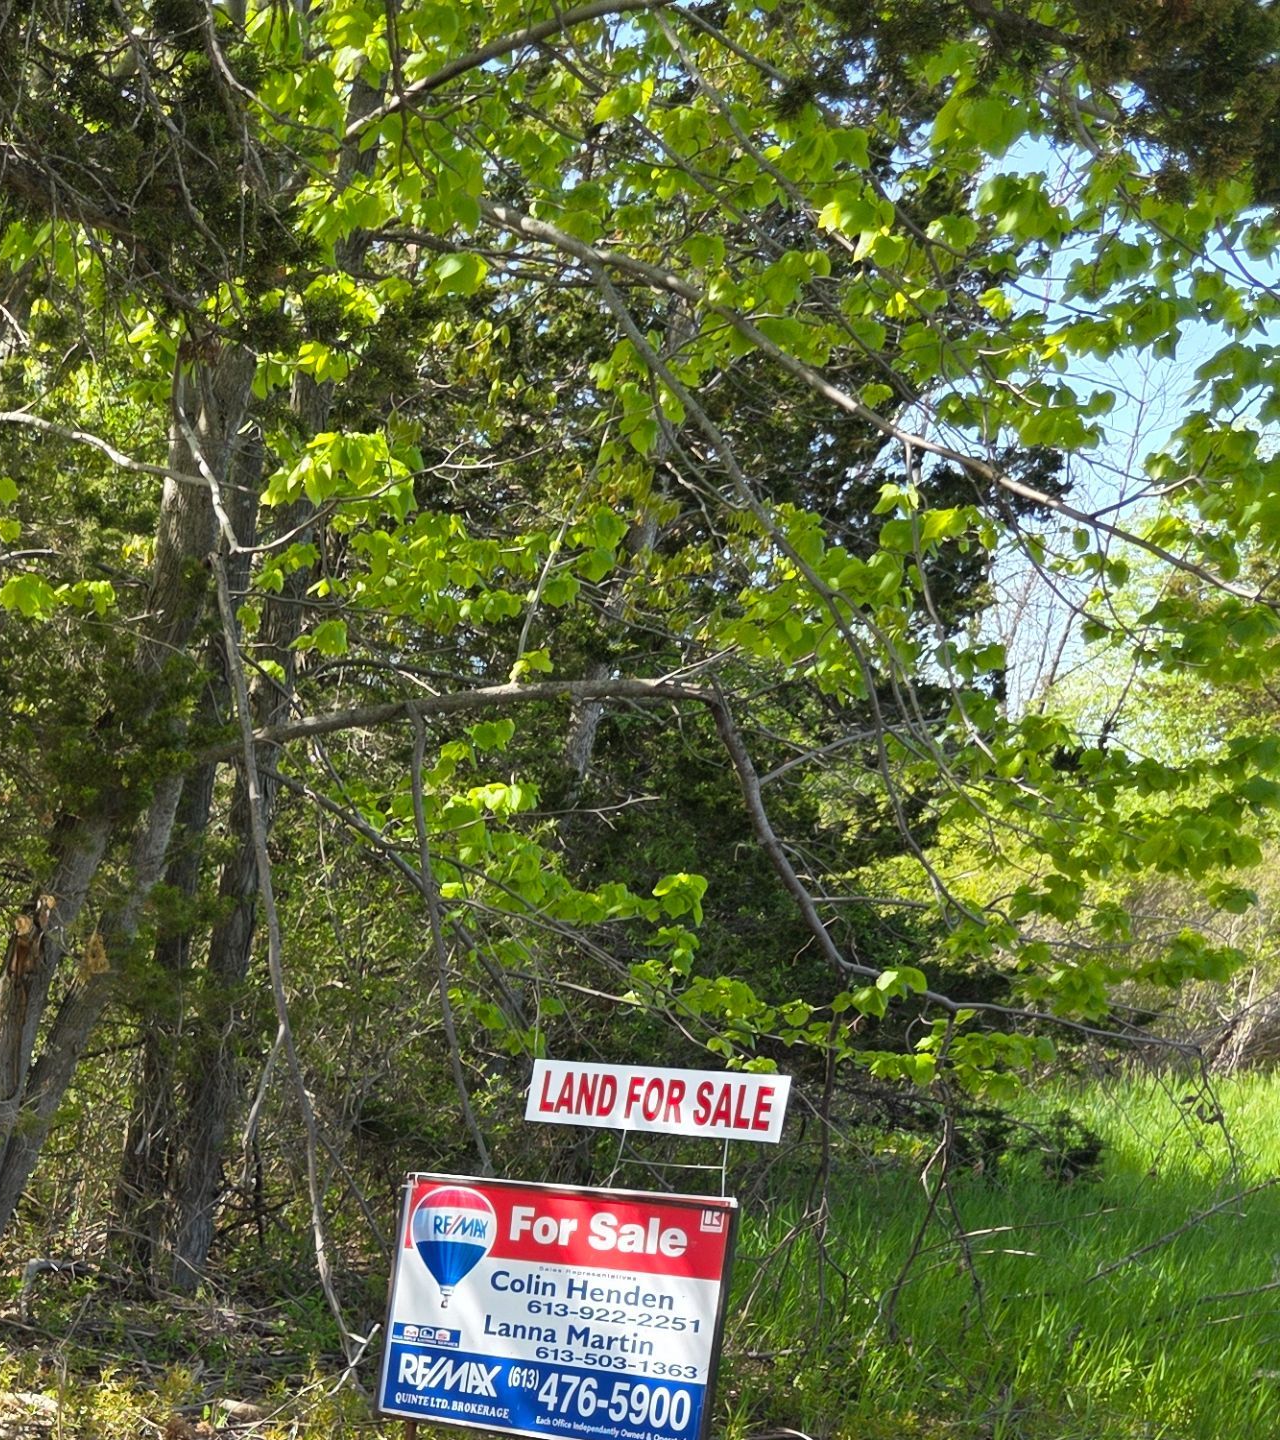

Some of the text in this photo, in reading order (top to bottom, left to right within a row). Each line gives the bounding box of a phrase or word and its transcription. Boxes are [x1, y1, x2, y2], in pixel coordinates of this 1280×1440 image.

[539, 1070, 775, 1131] LAND FOR SALE
[434, 1215, 488, 1240] RE/MAX
[509, 1206, 577, 1246] For
[590, 1212, 688, 1257] Sale
[490, 1271, 674, 1310] Colin Henden
[527, 1300, 700, 1334] 613-922-2251
[484, 1315, 557, 1344] Lanna
[567, 1325, 654, 1356] Martin
[535, 1346, 698, 1379] 613-503-1363
[395, 1392, 509, 1419] QUINTE LTD. BROKERAGE
[398, 1353, 690, 1431] RE/MAX (613) 476-5900
[536, 1416, 551, 1425] Each
[552, 1419, 571, 1429] Office
[621, 1430, 645, 1440] Owned
